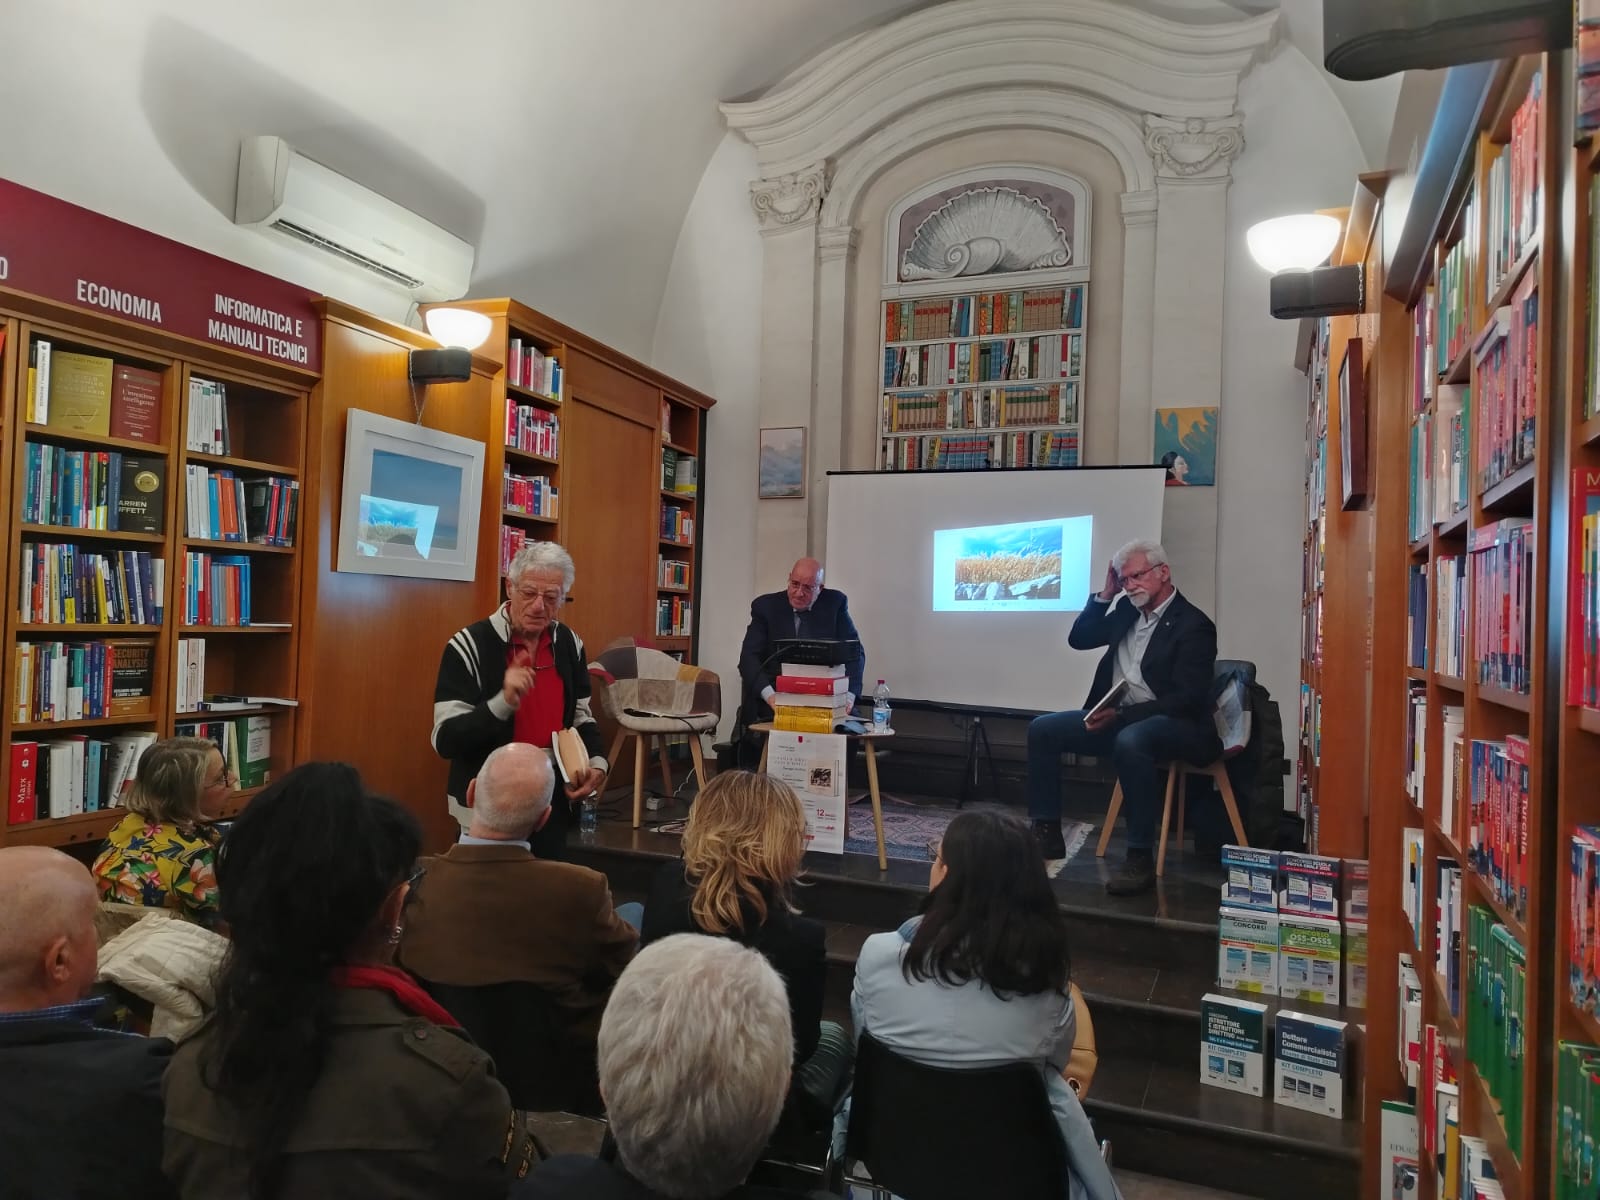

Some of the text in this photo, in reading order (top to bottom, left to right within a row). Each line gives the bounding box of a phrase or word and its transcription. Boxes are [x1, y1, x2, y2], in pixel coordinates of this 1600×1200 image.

[76, 279, 162, 323] ECONOMIA
[214, 293, 303, 338] INFORMATICA E
[208, 319, 308, 364] MANUALI TECNICI
[118, 500, 147, 508] ARREN
[118, 506, 147, 514] FFETT
[17, 776, 27, 804] Marx
[816, 808, 825, 817] 12
[1520, 798, 1529, 855] Turchia
[1233, 921, 1267, 931] CONCORSI
[1290, 934, 1332, 946] OSS-OSSS
[1282, 1031, 1308, 1044] Dottore
[1282, 1039, 1337, 1058] Commercialista
[1281, 1062, 1323, 1077] KIT COMPLETO
